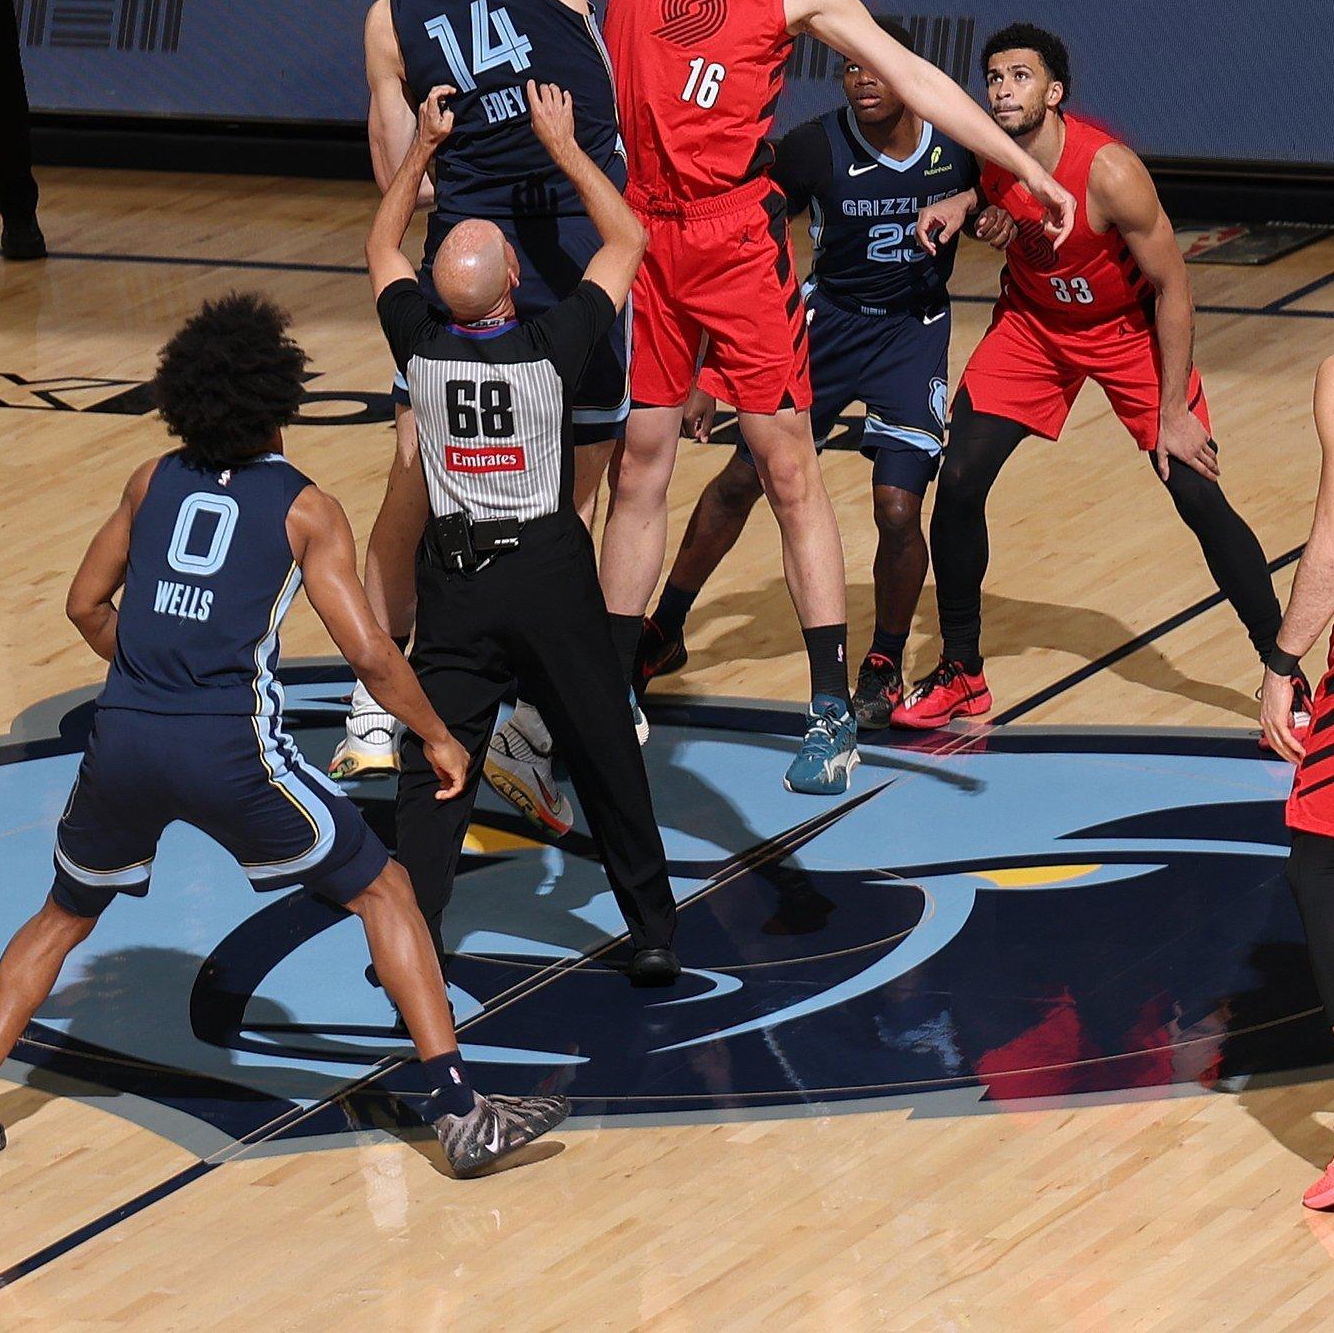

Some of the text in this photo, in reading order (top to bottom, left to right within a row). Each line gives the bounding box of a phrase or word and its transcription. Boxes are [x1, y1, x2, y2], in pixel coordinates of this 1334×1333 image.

[681, 56, 727, 110] 16
[483, 85, 528, 126] EDEY
[1049, 276, 1095, 305] 33
[446, 379, 515, 439] 68
[452, 451, 518, 468] Emirates
[166, 490, 240, 577] 0
[154, 579, 215, 623] WELLS
